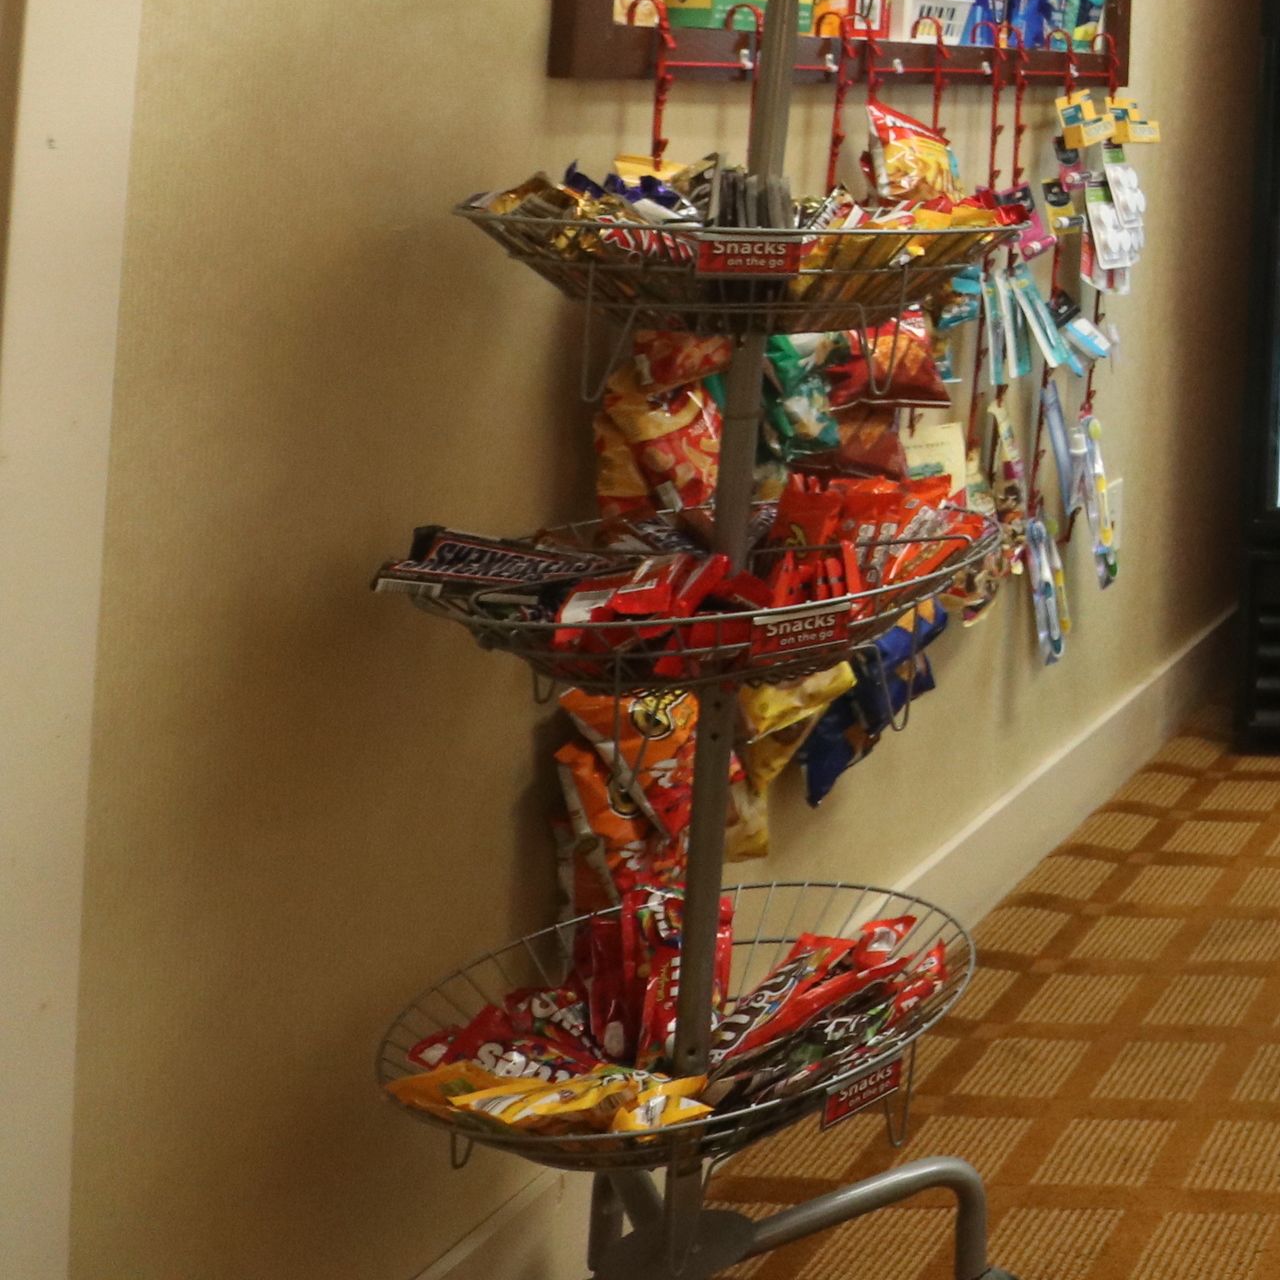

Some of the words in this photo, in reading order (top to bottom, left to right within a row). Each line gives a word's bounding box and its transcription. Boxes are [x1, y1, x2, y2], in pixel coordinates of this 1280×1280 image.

[713, 241, 787, 256] Snacks
[727, 258, 743, 267] on
[746, 257, 766, 267] the
[767, 258, 785, 269] go
[766, 613, 836, 638] Snacks
[780, 634, 796, 645] on
[798, 630, 817, 642] the
[818, 629, 834, 642] go
